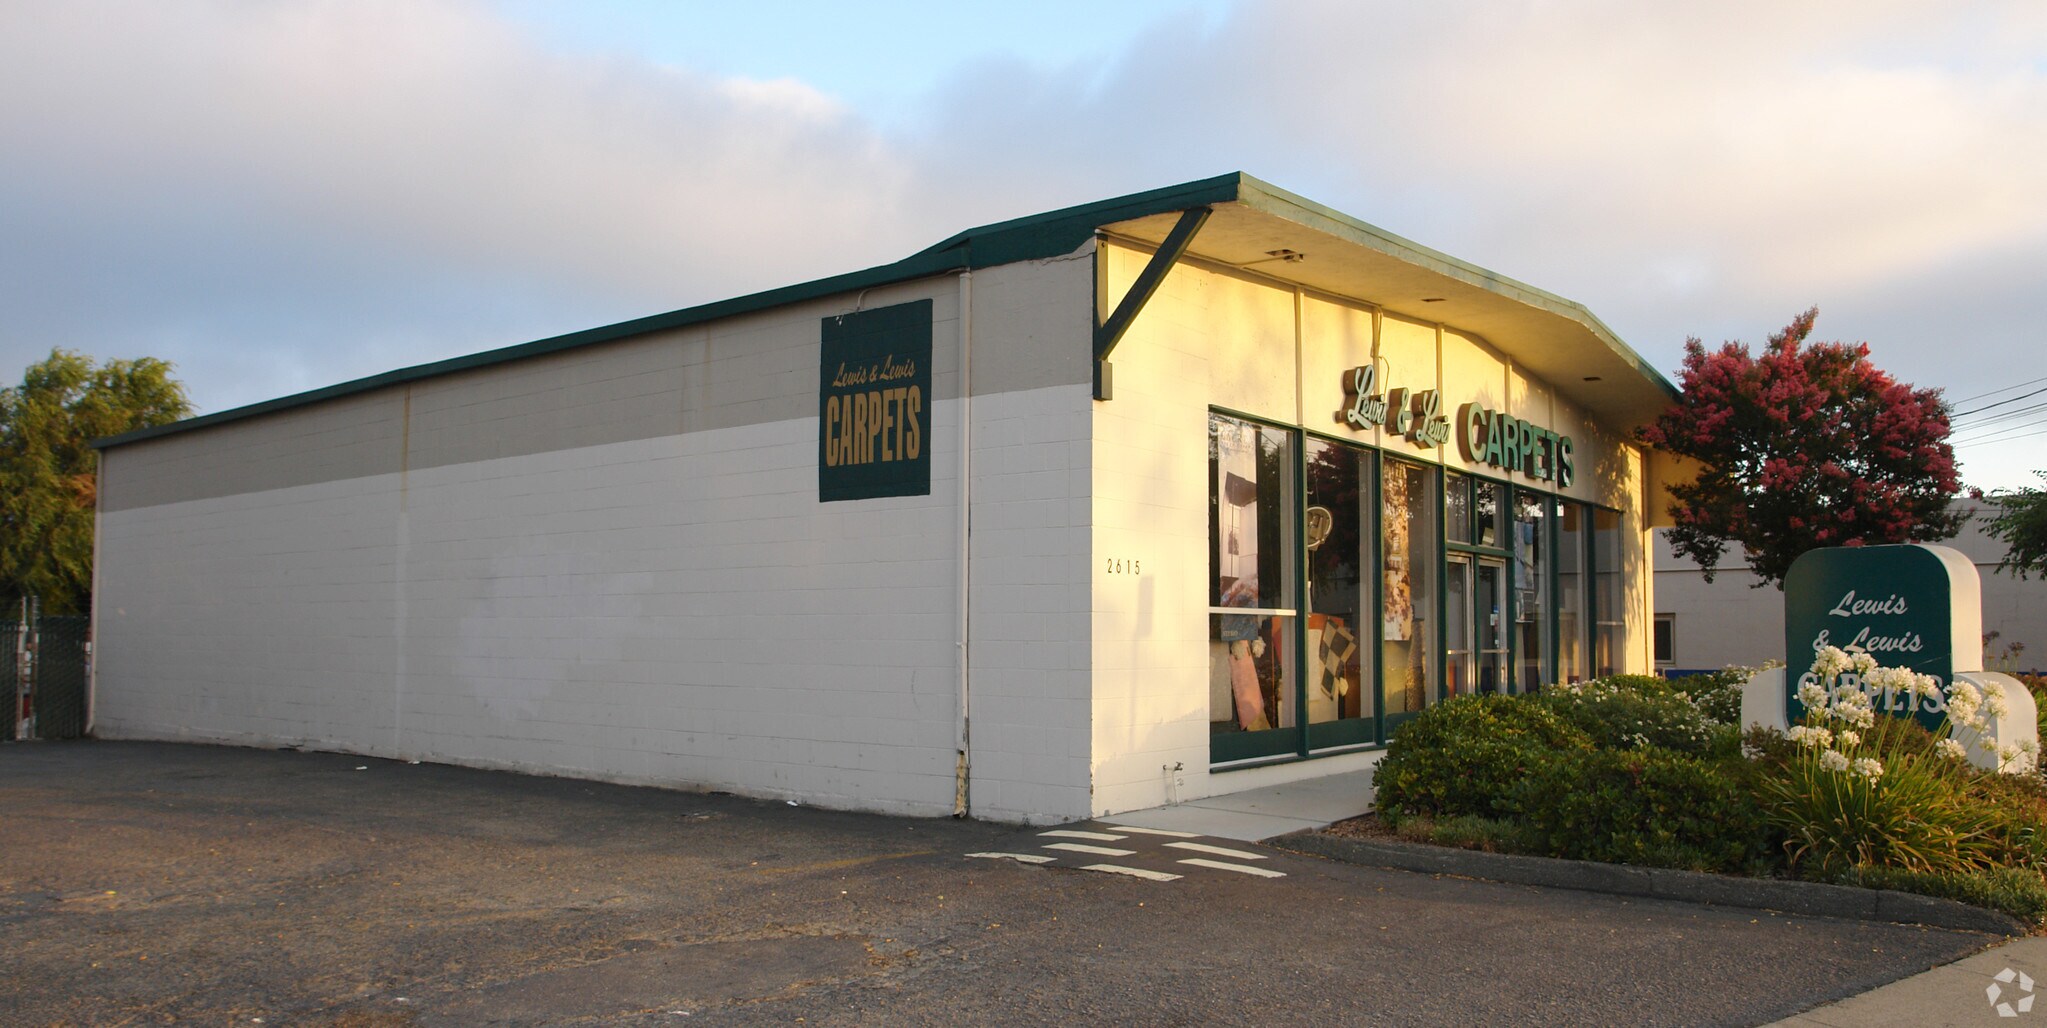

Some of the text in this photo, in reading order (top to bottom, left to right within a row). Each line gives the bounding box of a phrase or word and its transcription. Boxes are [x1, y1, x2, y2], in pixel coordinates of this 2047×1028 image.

[833, 354, 915, 387] Lewis & Lewis
[826, 385, 921, 467] CARPETS
[1346, 364, 1574, 488] Lewis & Lewis CARPETS
[1107, 558, 1140, 575] 2615
[1829, 590, 1908, 617] Lewis
[1812, 626, 1923, 652] & Lewis
